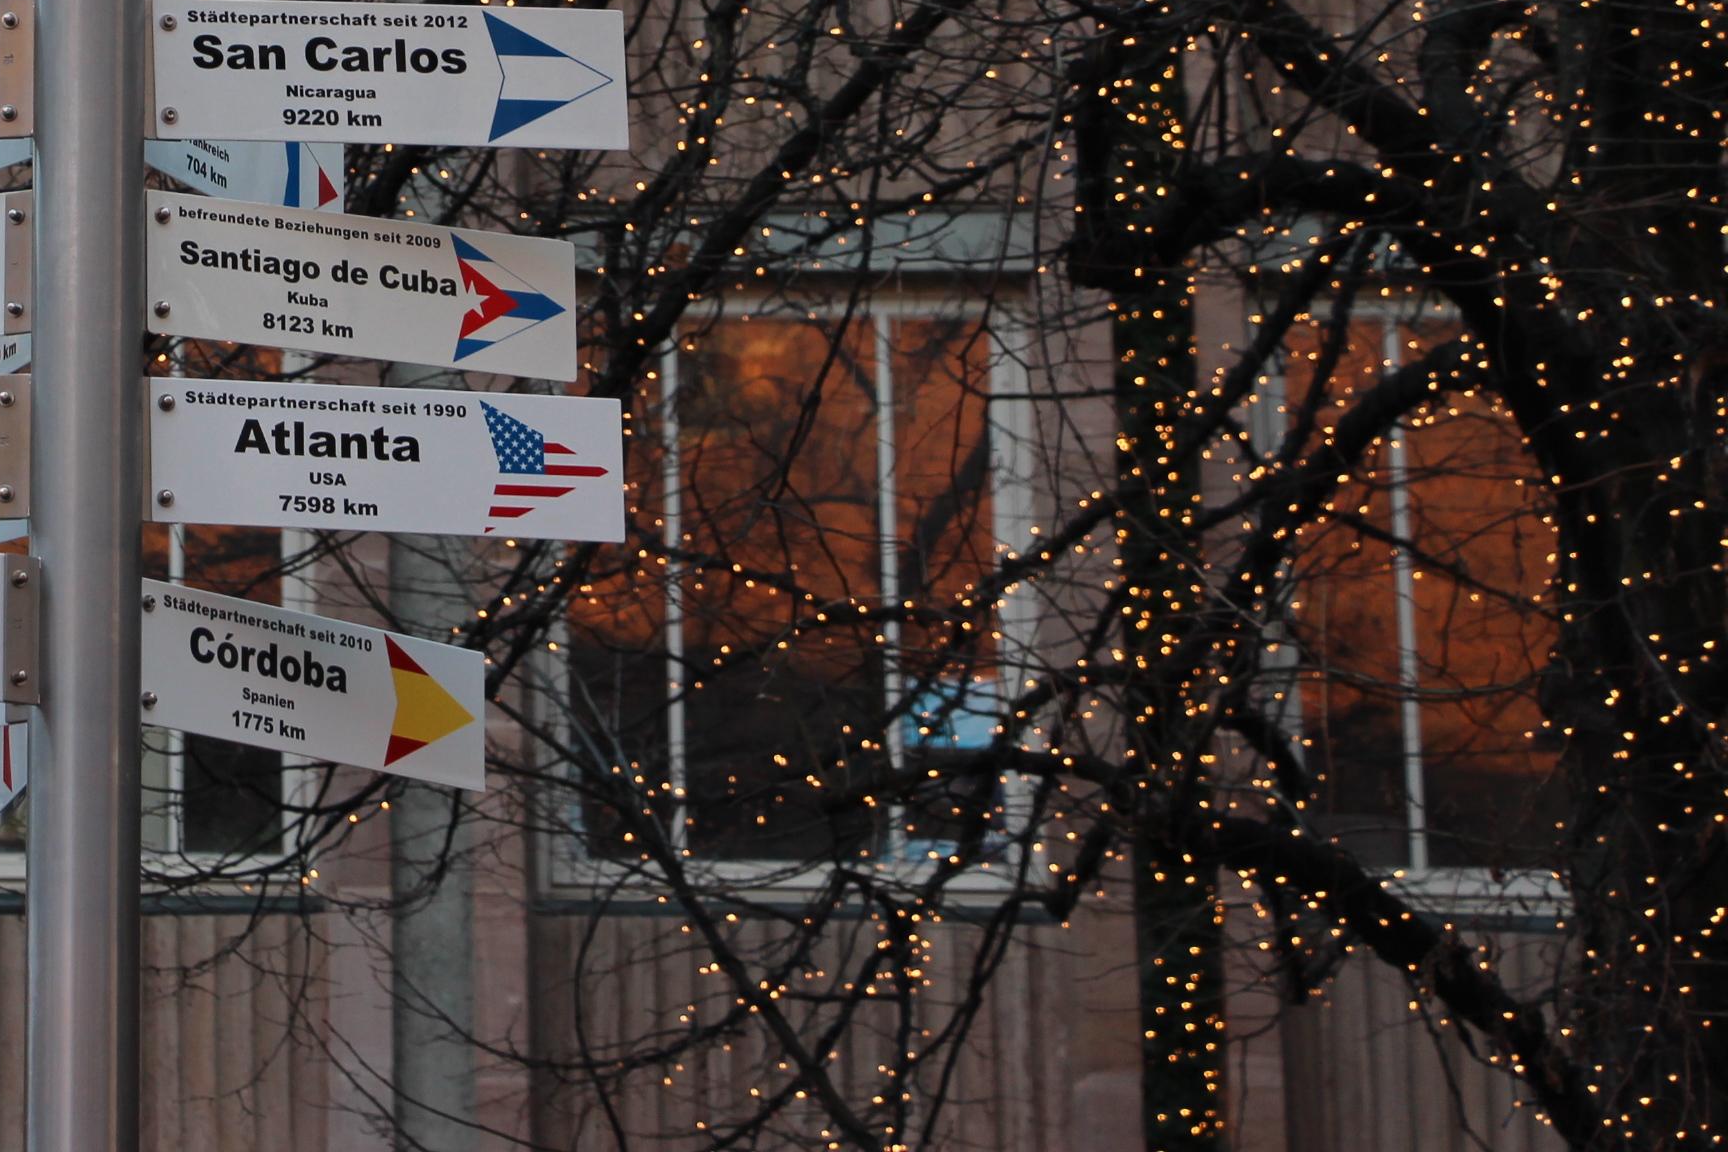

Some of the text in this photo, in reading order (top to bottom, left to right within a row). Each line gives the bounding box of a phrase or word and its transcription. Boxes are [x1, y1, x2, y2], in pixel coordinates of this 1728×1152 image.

[188, 10, 468, 28] Städtepartnerschaft seit 2012
[192, 34, 467, 74] San Carlos
[286, 85, 376, 102] Nicaragua
[283, 109, 382, 127] 9220 km
[184, 139, 229, 162] ankreich
[186, 154, 227, 189] 704 km
[179, 206, 441, 248] befreundete Beziehungen seit 2009
[180, 240, 457, 296] Santiago de Cuba
[288, 291, 328, 308] Kuba
[263, 312, 353, 338] 8123 km
[3, 343, 16, 360] km
[185, 390, 466, 418] Städtepartnerschaft seit 1990
[234, 419, 420, 462] Atlanta
[310, 472, 346, 486] USA
[279, 495, 378, 516] 7598 km
[164, 594, 372, 652] Städtepartnerschaft seit 2010
[190, 624, 347, 694] Córdoba
[242, 687, 294, 710] Spanien
[232, 710, 305, 741] 1775 km
